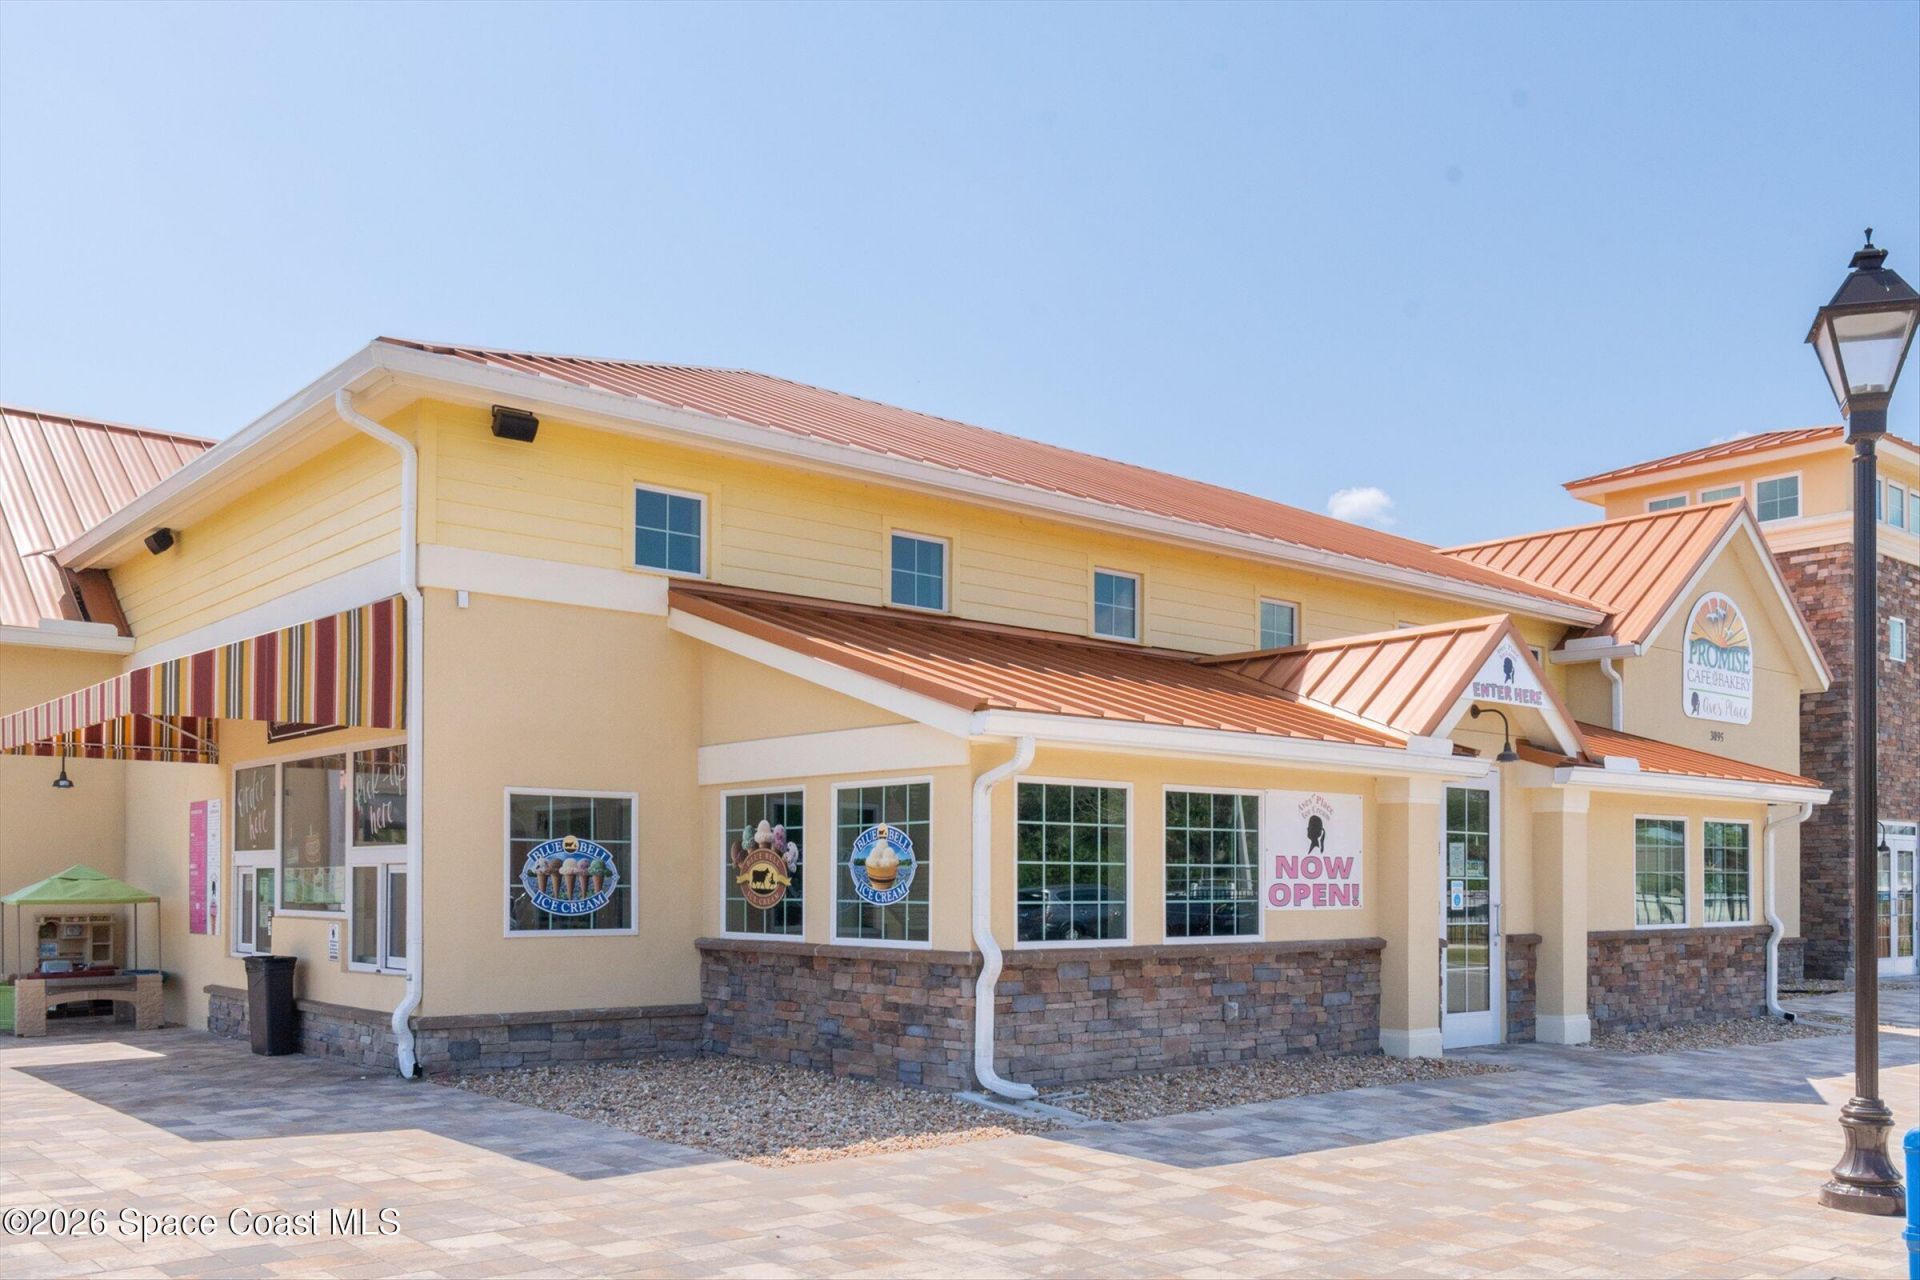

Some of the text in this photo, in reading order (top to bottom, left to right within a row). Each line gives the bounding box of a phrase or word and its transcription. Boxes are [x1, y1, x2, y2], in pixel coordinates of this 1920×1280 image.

[1688, 640, 1750, 674] PROMISE
[1687, 667, 1711, 685] CAFE
[1718, 672, 1751, 691] BAKERY
[1472, 682, 1543, 706] ENTER HERE
[369, 800, 393, 835] here
[532, 841, 607, 860] BLUE BELL
[857, 829, 909, 850] BLUE BELL
[1275, 855, 1354, 880] NOW
[536, 894, 605, 913] ICE CREAM
[859, 883, 907, 903] ICE CREAM
[1268, 883, 1360, 907] OPEN!
